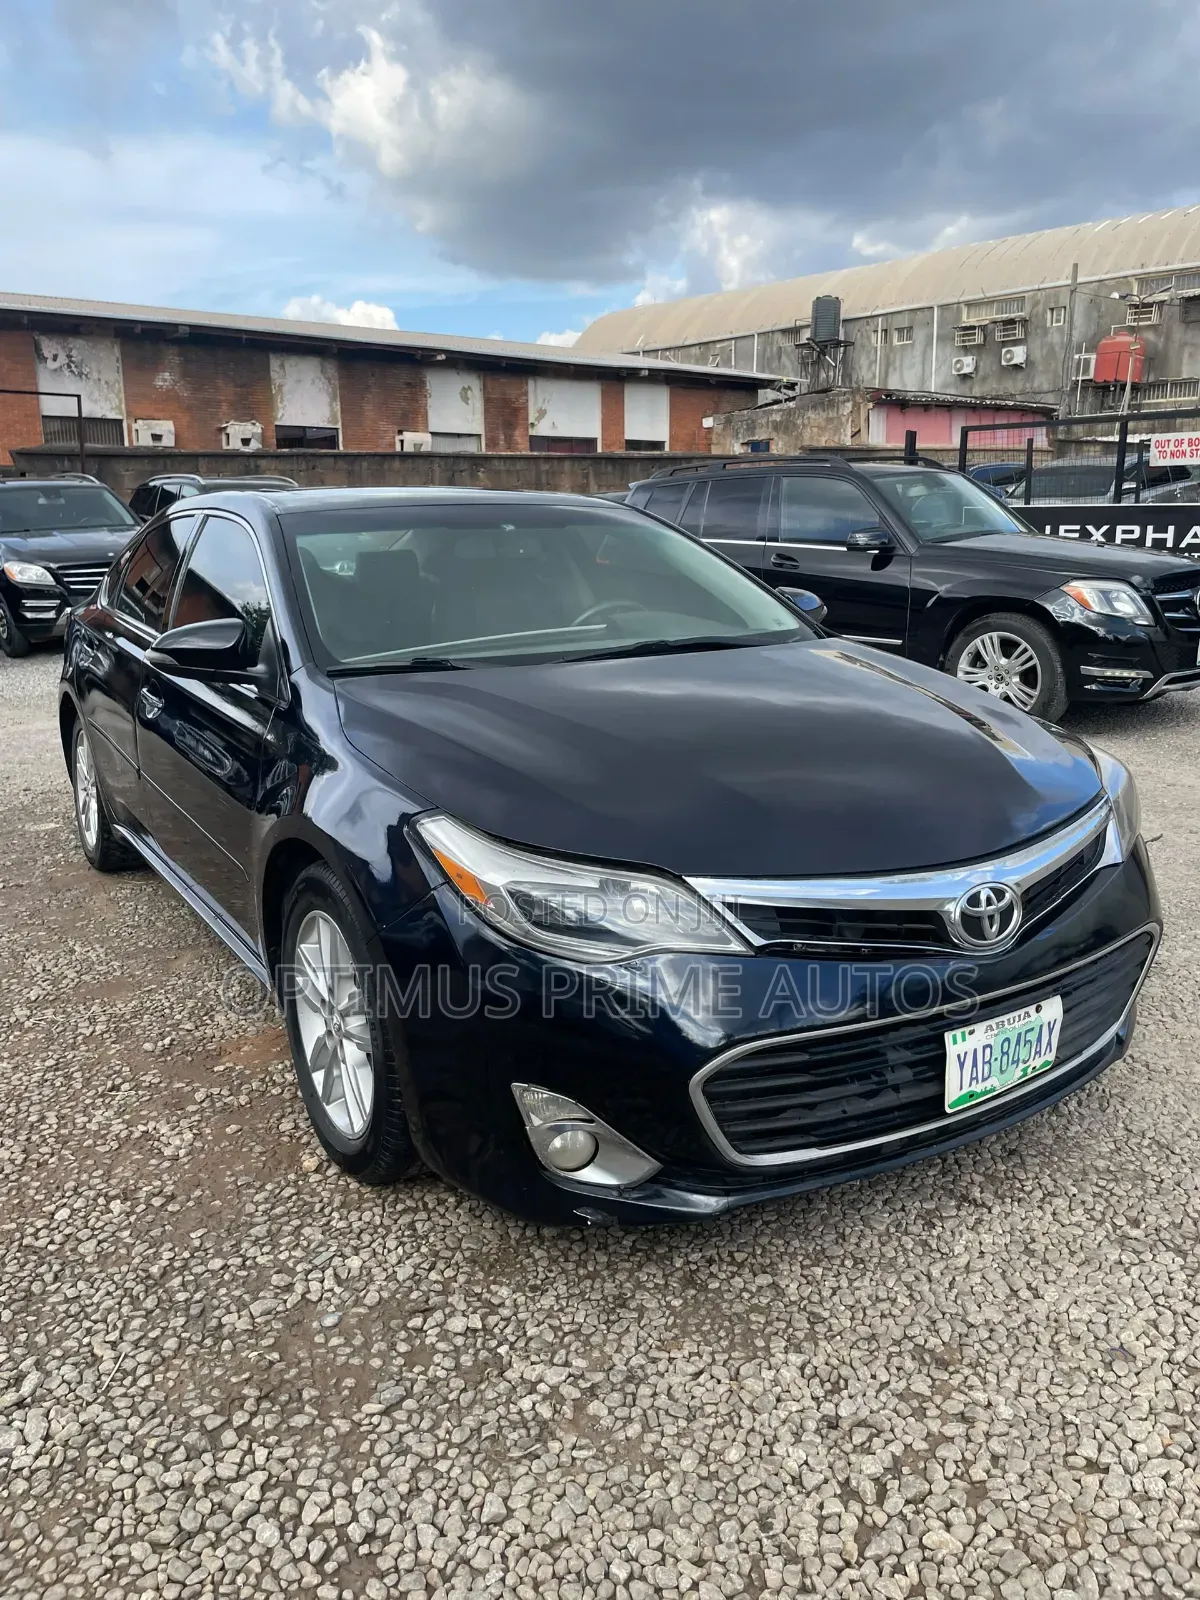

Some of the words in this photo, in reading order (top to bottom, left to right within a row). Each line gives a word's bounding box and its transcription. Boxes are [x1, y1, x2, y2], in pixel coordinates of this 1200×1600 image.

[1154, 439, 1171, 449] OUT
[1173, 438, 1185, 449] OF
[1158, 450, 1168, 460] TO
[1169, 449, 1187, 459] NON
[1189, 448, 1200, 459] ST
[984, 1010, 1032, 1035] ABUJA
[956, 1018, 1057, 1092] YAB-845AX
